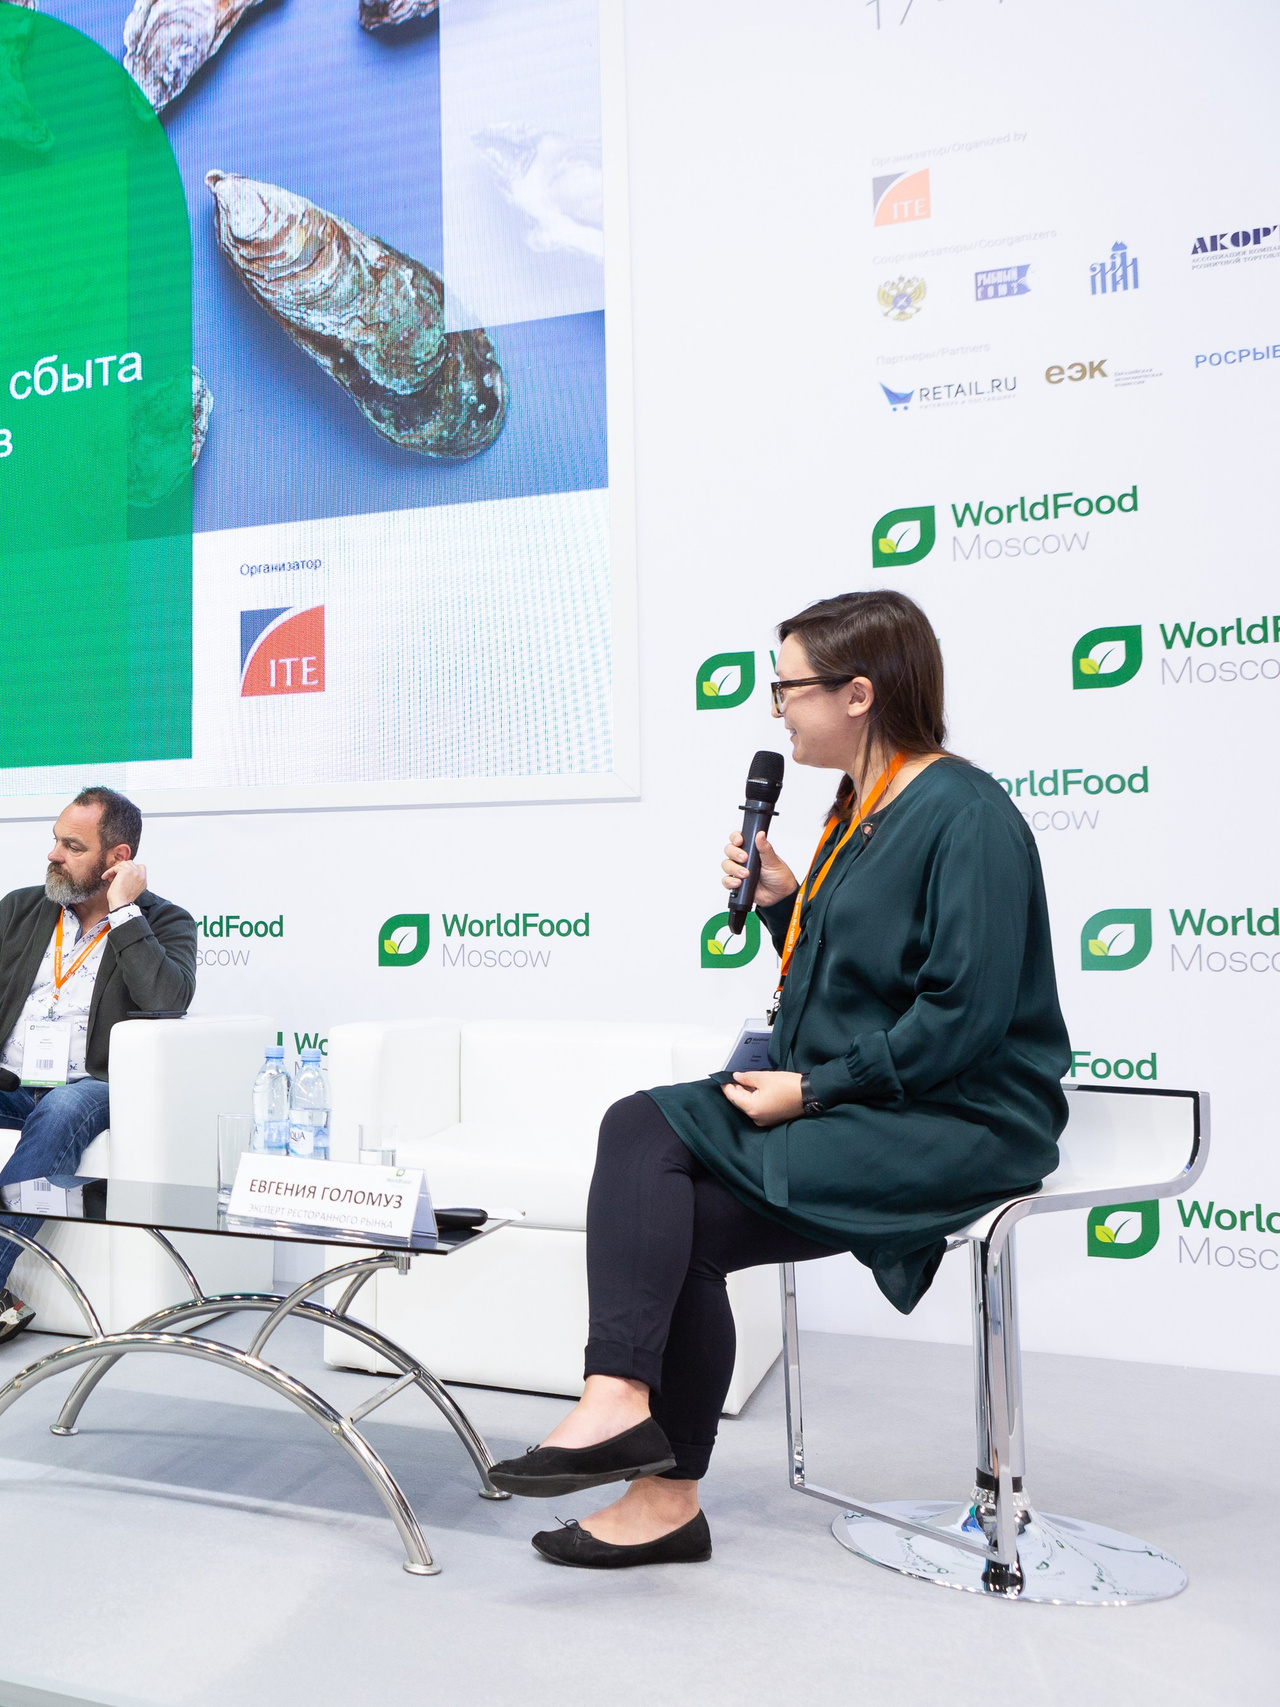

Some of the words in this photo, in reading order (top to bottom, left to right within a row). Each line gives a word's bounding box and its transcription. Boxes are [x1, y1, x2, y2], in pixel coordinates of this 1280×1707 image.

[892, 198, 927, 220] ITE
[9, 350, 144, 401] сбыта
[919, 375, 1018, 402] RETAIL.RU
[951, 485, 1139, 529] WorldFood
[952, 530, 1091, 562] Moscow
[239, 558, 323, 577] Организатор
[1159, 615, 1280, 650] World
[270, 656, 319, 688] ITE
[1161, 656, 1280, 685] Mosco
[989, 766, 1149, 797] orldFood
[195, 914, 284, 938] rldFood
[442, 912, 590, 938] WorldFood
[1169, 907, 1280, 937] World
[196, 949, 251, 966] scow
[442, 943, 551, 968] Moscow
[1171, 944, 1280, 973] Mosc
[249, 1178, 317, 1200] ЕВГЕНИЯ
[320, 1186, 403, 1210] ГОЛОМУЗ
[247, 1203, 286, 1216] ЭКСПЕРТ
[286, 1208, 358, 1225] РЕСТОРАННОГО
[359, 1217, 393, 1230] РЫНКА
[1178, 1236, 1280, 1271] Mosc
